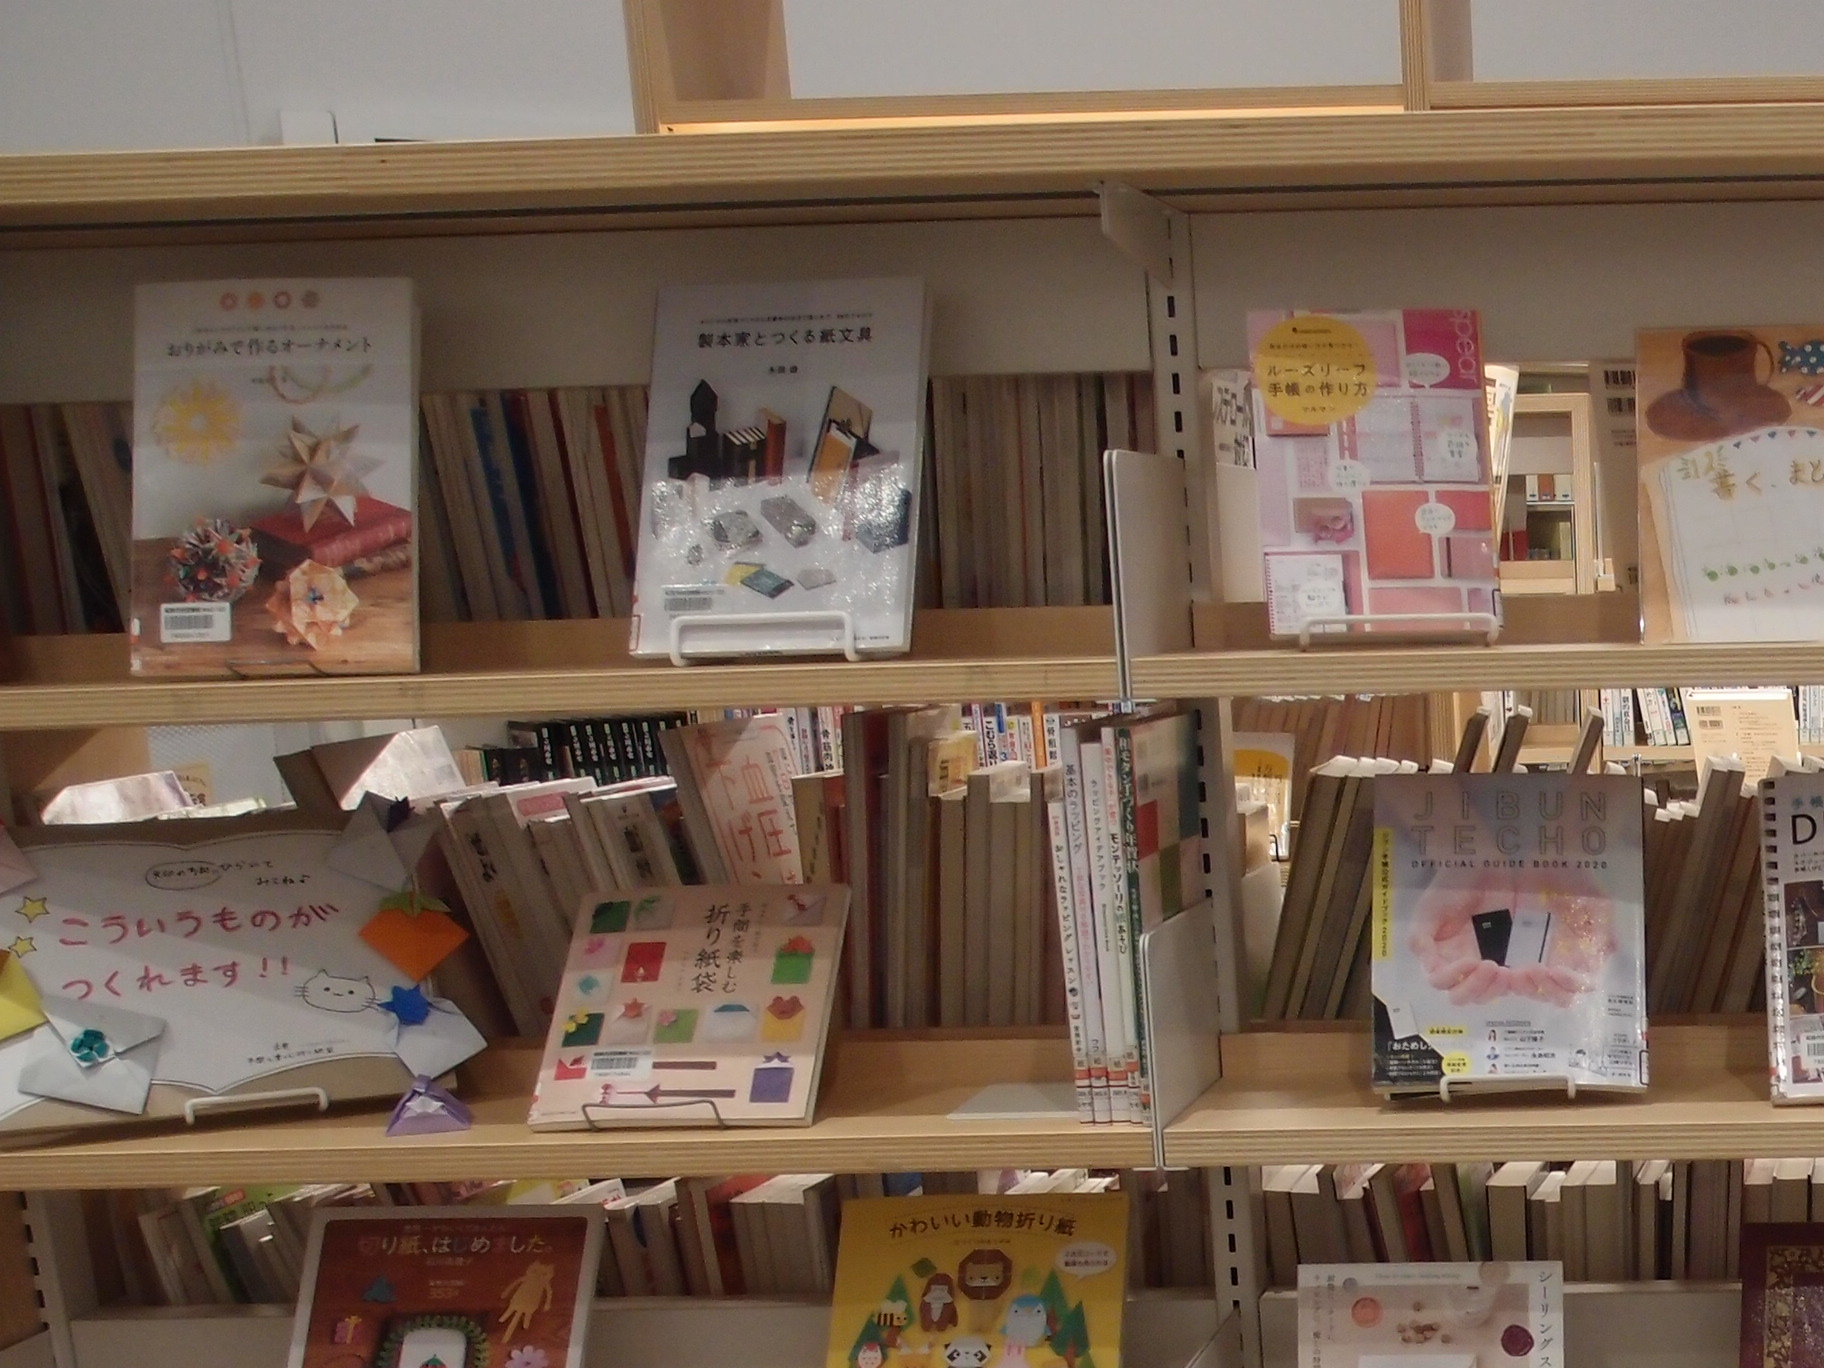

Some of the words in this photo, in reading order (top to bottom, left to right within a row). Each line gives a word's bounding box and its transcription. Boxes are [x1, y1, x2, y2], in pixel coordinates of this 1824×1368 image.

[698, 327, 873, 348] 製本家とつくる紙文具
[1267, 363, 1367, 378] ルーズリーフ
[1267, 382, 1368, 398] 手帳の作り方
[1414, 791, 1608, 821] JIBUN
[1410, 825, 1608, 856] TECHO
[1411, 860, 1476, 870] OFFICIAL
[1483, 860, 1526, 869] GUIDE
[1533, 860, 1569, 869] BOOK
[1576, 860, 1609, 869] 2020
[60, 902, 339, 947] こういうものが
[690, 903, 732, 994] 折り紙袋
[721, 902, 752, 994] 手間を楽しむ
[61, 956, 290, 1001] つくれます!!
[888, 1209, 1077, 1240] かわいい動物折り紙
